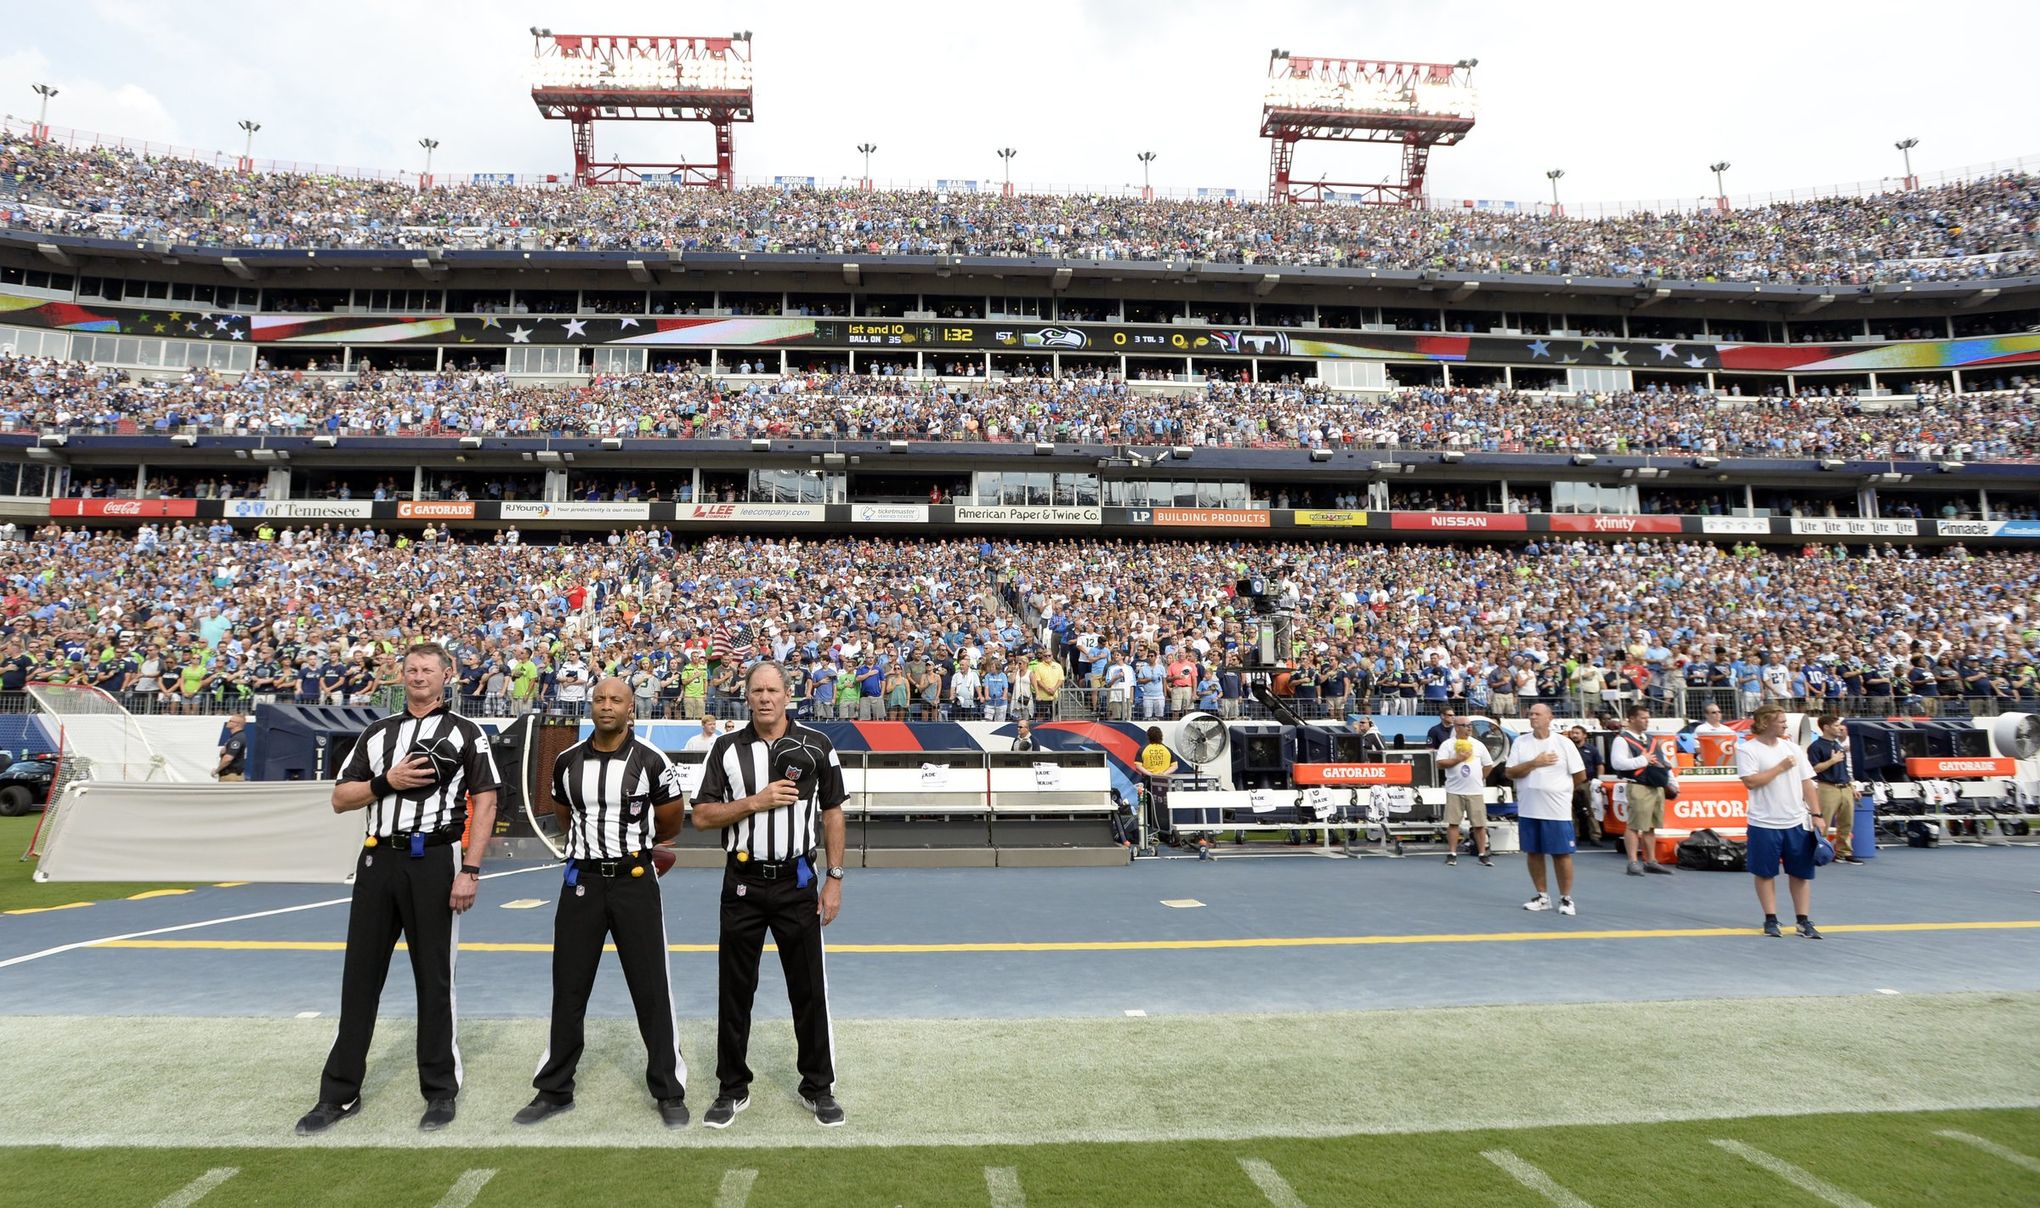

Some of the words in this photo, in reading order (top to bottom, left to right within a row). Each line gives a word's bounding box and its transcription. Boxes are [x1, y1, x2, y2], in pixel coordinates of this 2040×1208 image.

[849, 324, 863, 334] 1st
[867, 324, 888, 334] and
[892, 325, 904, 334] 10
[944, 328, 973, 341] 1:32
[888, 336, 902, 344] 35
[996, 332, 1013, 340] 1ST
[103, 501, 142, 514] Coca-Cola
[265, 503, 281, 516] of
[286, 504, 360, 517] Tennessee
[400, 504, 411, 516] G
[415, 505, 472, 515] GATORADE
[708, 505, 737, 514] LEE
[740, 508, 810, 517] leecompany.com
[959, 508, 1006, 519] American
[1011, 508, 1041, 521] Paper
[1042, 509, 1051, 520] &
[1052, 509, 1081, 520] Twine
[1084, 509, 1099, 520] Co.
[1132, 511, 1150, 522] LP
[1158, 513, 1208, 522] BUILDING
[1211, 513, 1266, 523] PRODUCTS
[1432, 516, 1487, 527] NISSAN
[1595, 516, 1636, 531] xfinity
[1800, 522, 1817, 533] Lite
[1824, 522, 1841, 533] Lite
[1848, 522, 1865, 534] Lite
[1872, 522, 1889, 534] Lite
[1896, 522, 1912, 534] Lite
[1940, 522, 1988, 535] Pinnacle
[1086, 638, 1095, 648] 12
[1771, 672, 1785, 684] 27
[1808, 671, 1822, 684] 10
[1661, 741, 1675, 756] G
[1720, 740, 1735, 755] G
[1939, 761, 1996, 771] GATORADE
[1323, 767, 1386, 778] GATORADE
[1674, 800, 1748, 818] GATOR
